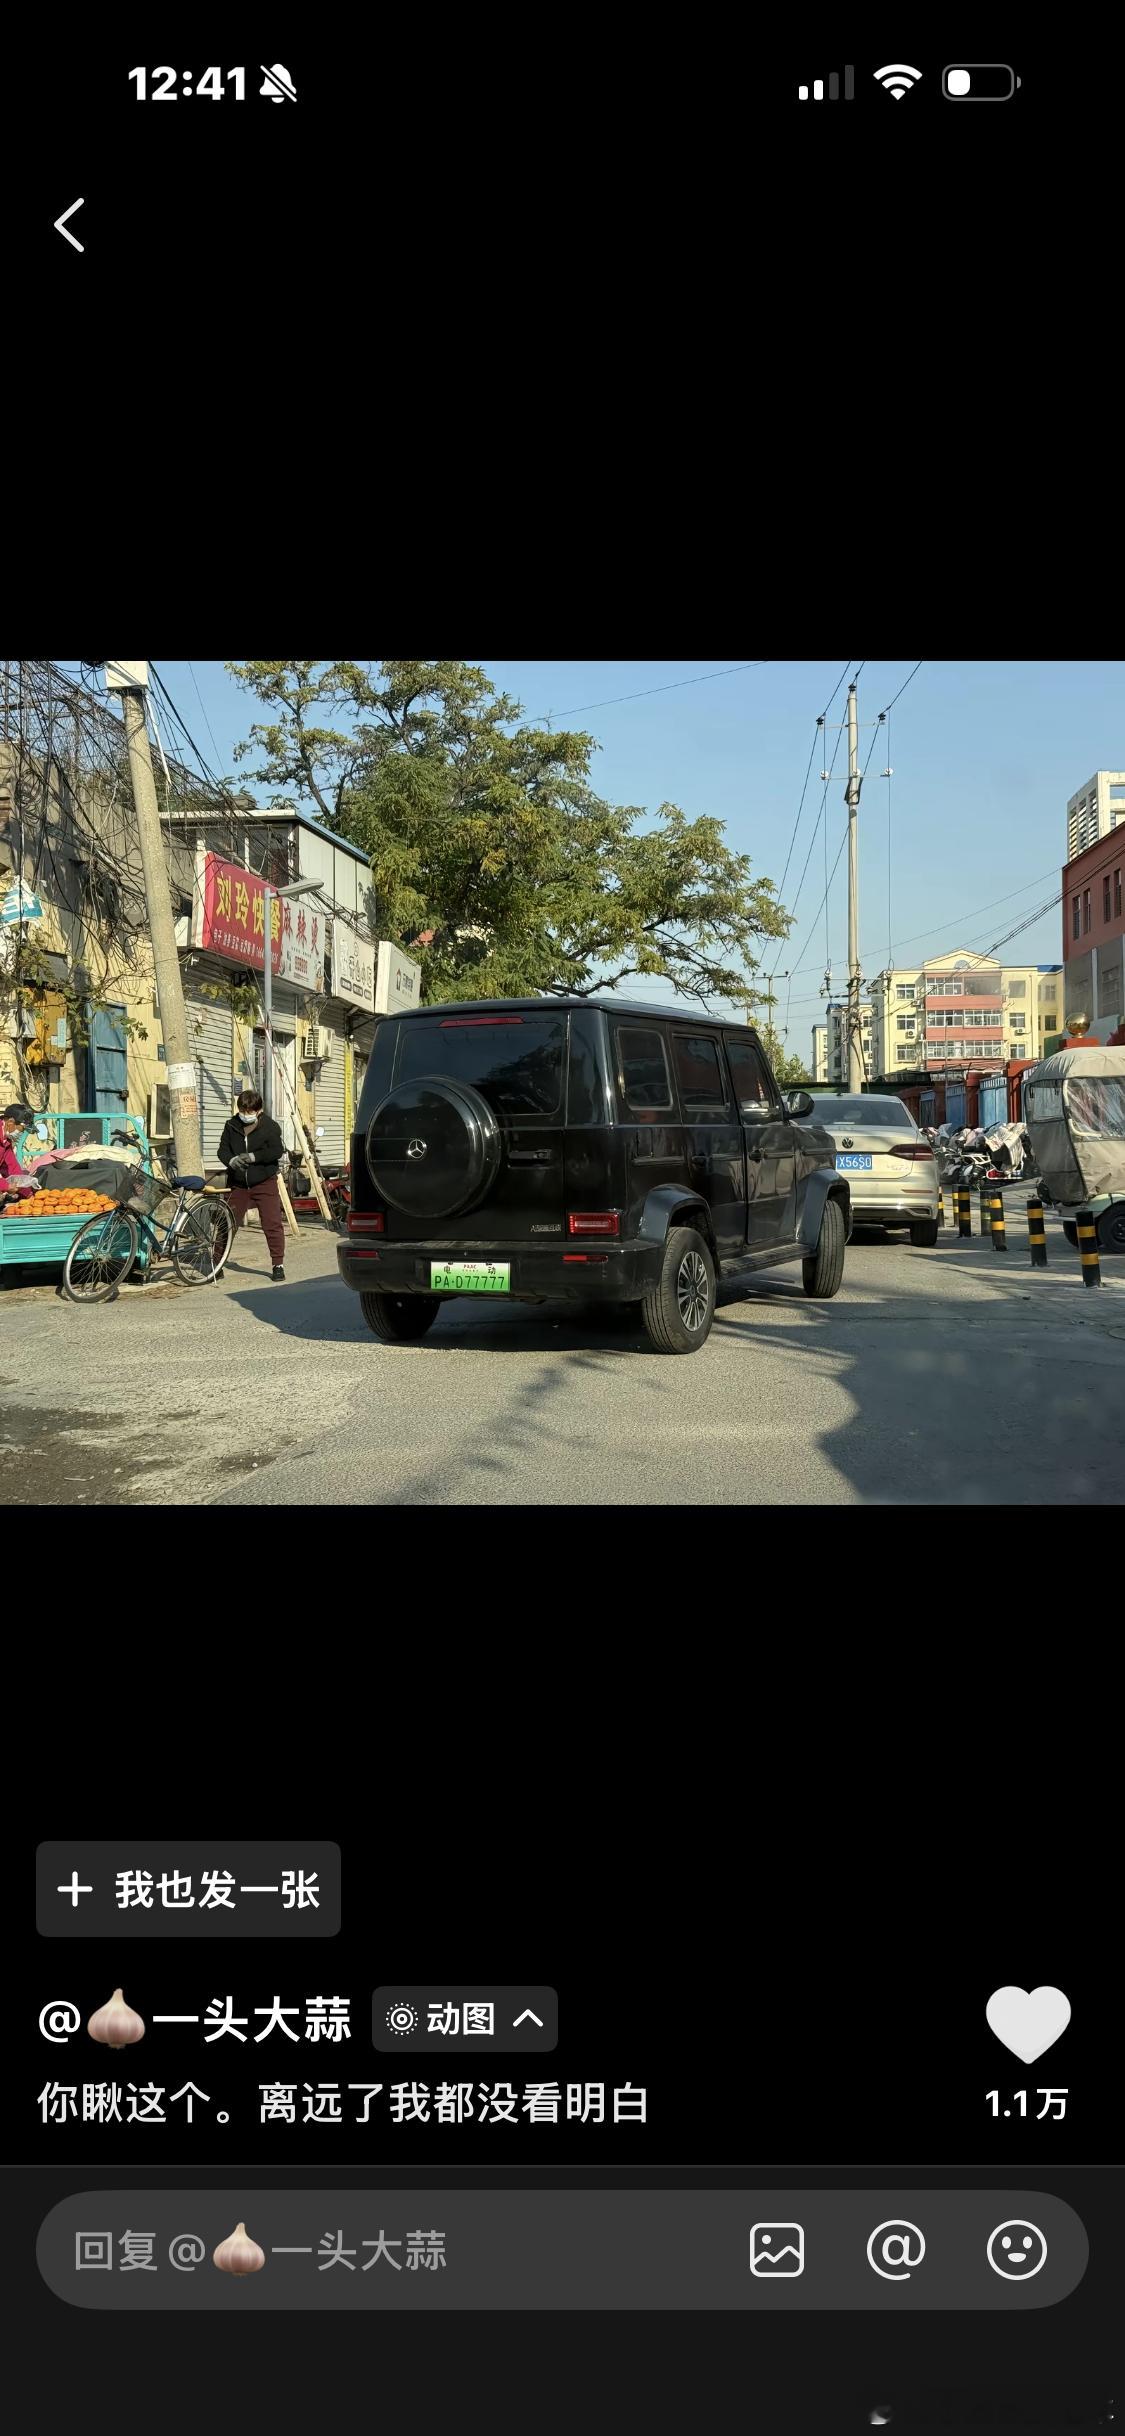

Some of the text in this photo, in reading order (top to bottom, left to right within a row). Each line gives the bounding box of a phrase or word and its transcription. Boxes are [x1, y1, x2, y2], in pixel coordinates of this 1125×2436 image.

[215, 870, 281, 943] 刘玲快餐
[443, 1265, 452, 1274] 电
[487, 1266, 496, 1275] 动
